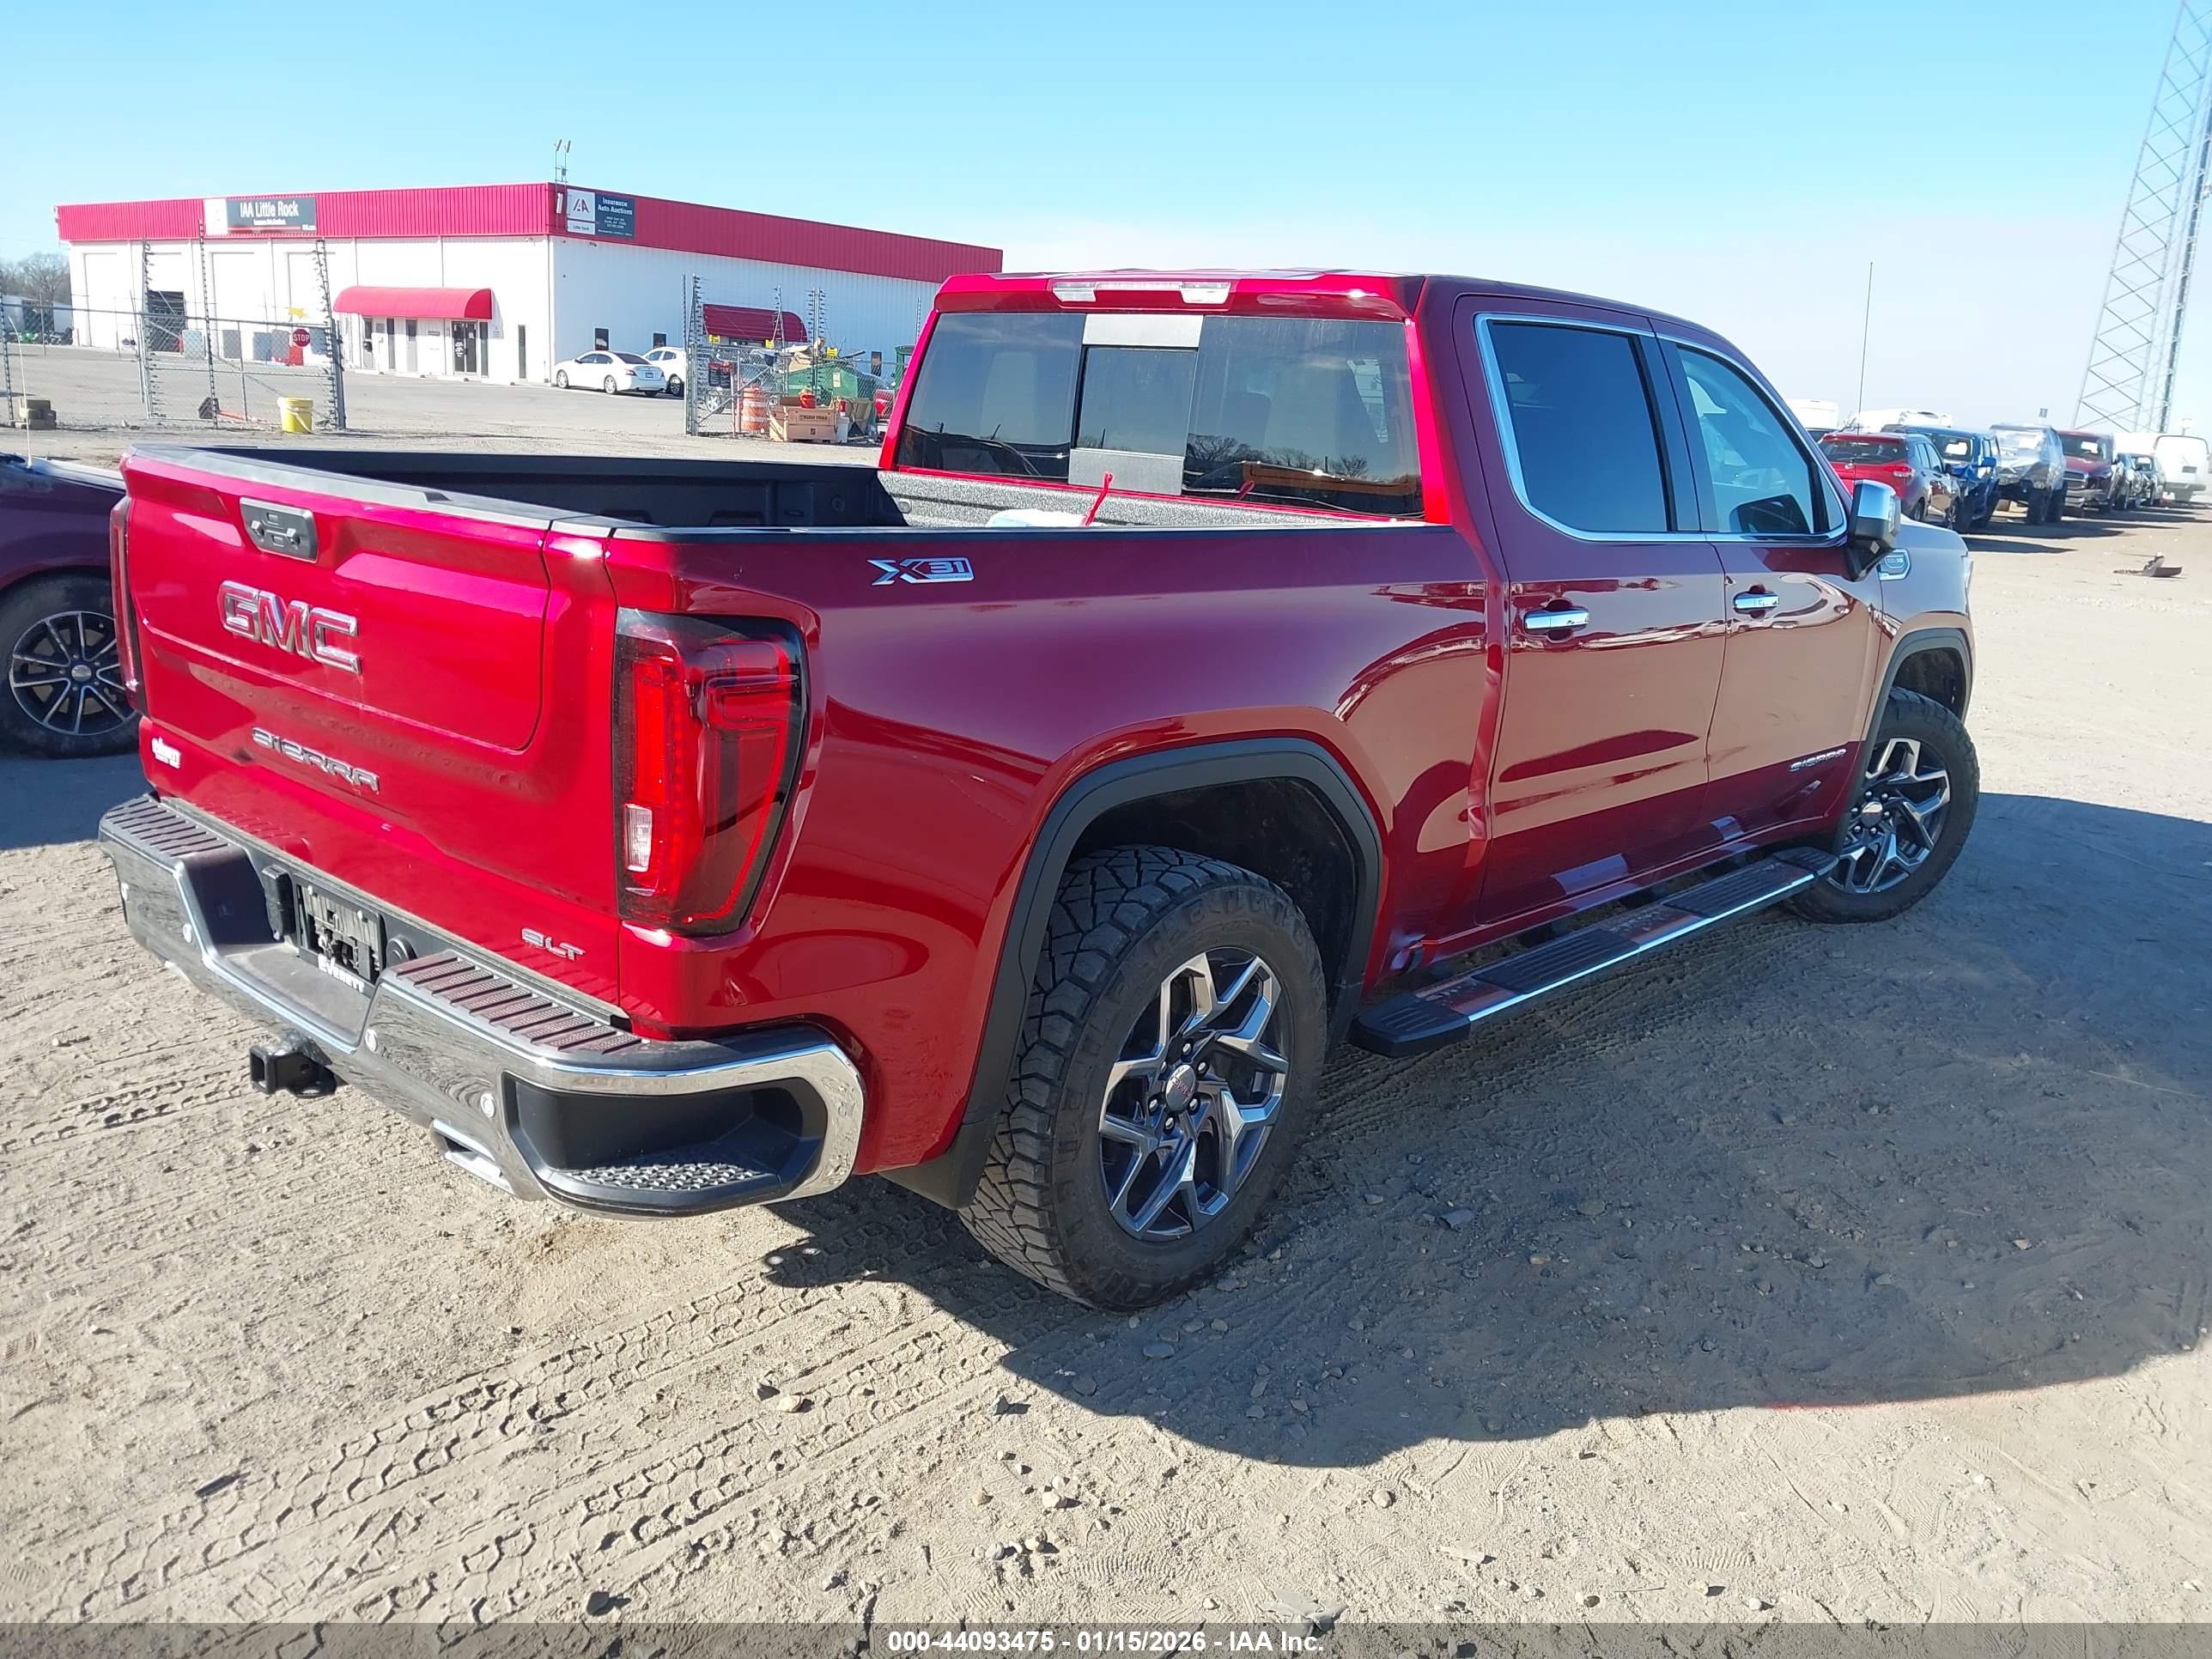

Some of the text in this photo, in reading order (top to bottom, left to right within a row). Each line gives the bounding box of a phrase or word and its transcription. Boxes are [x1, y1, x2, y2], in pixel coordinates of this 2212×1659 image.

[240, 200, 299, 218] IAA Little Rock
[597, 204, 633, 216] Auto Auctions
[602, 197, 628, 208] Insurance
[293, 333, 310, 343] STOP
[866, 557, 975, 586] X31
[216, 580, 362, 674] GMC
[252, 727, 380, 795] SIERRA
[1788, 748, 1847, 773] SIERRA
[521, 927, 586, 961] SLT
